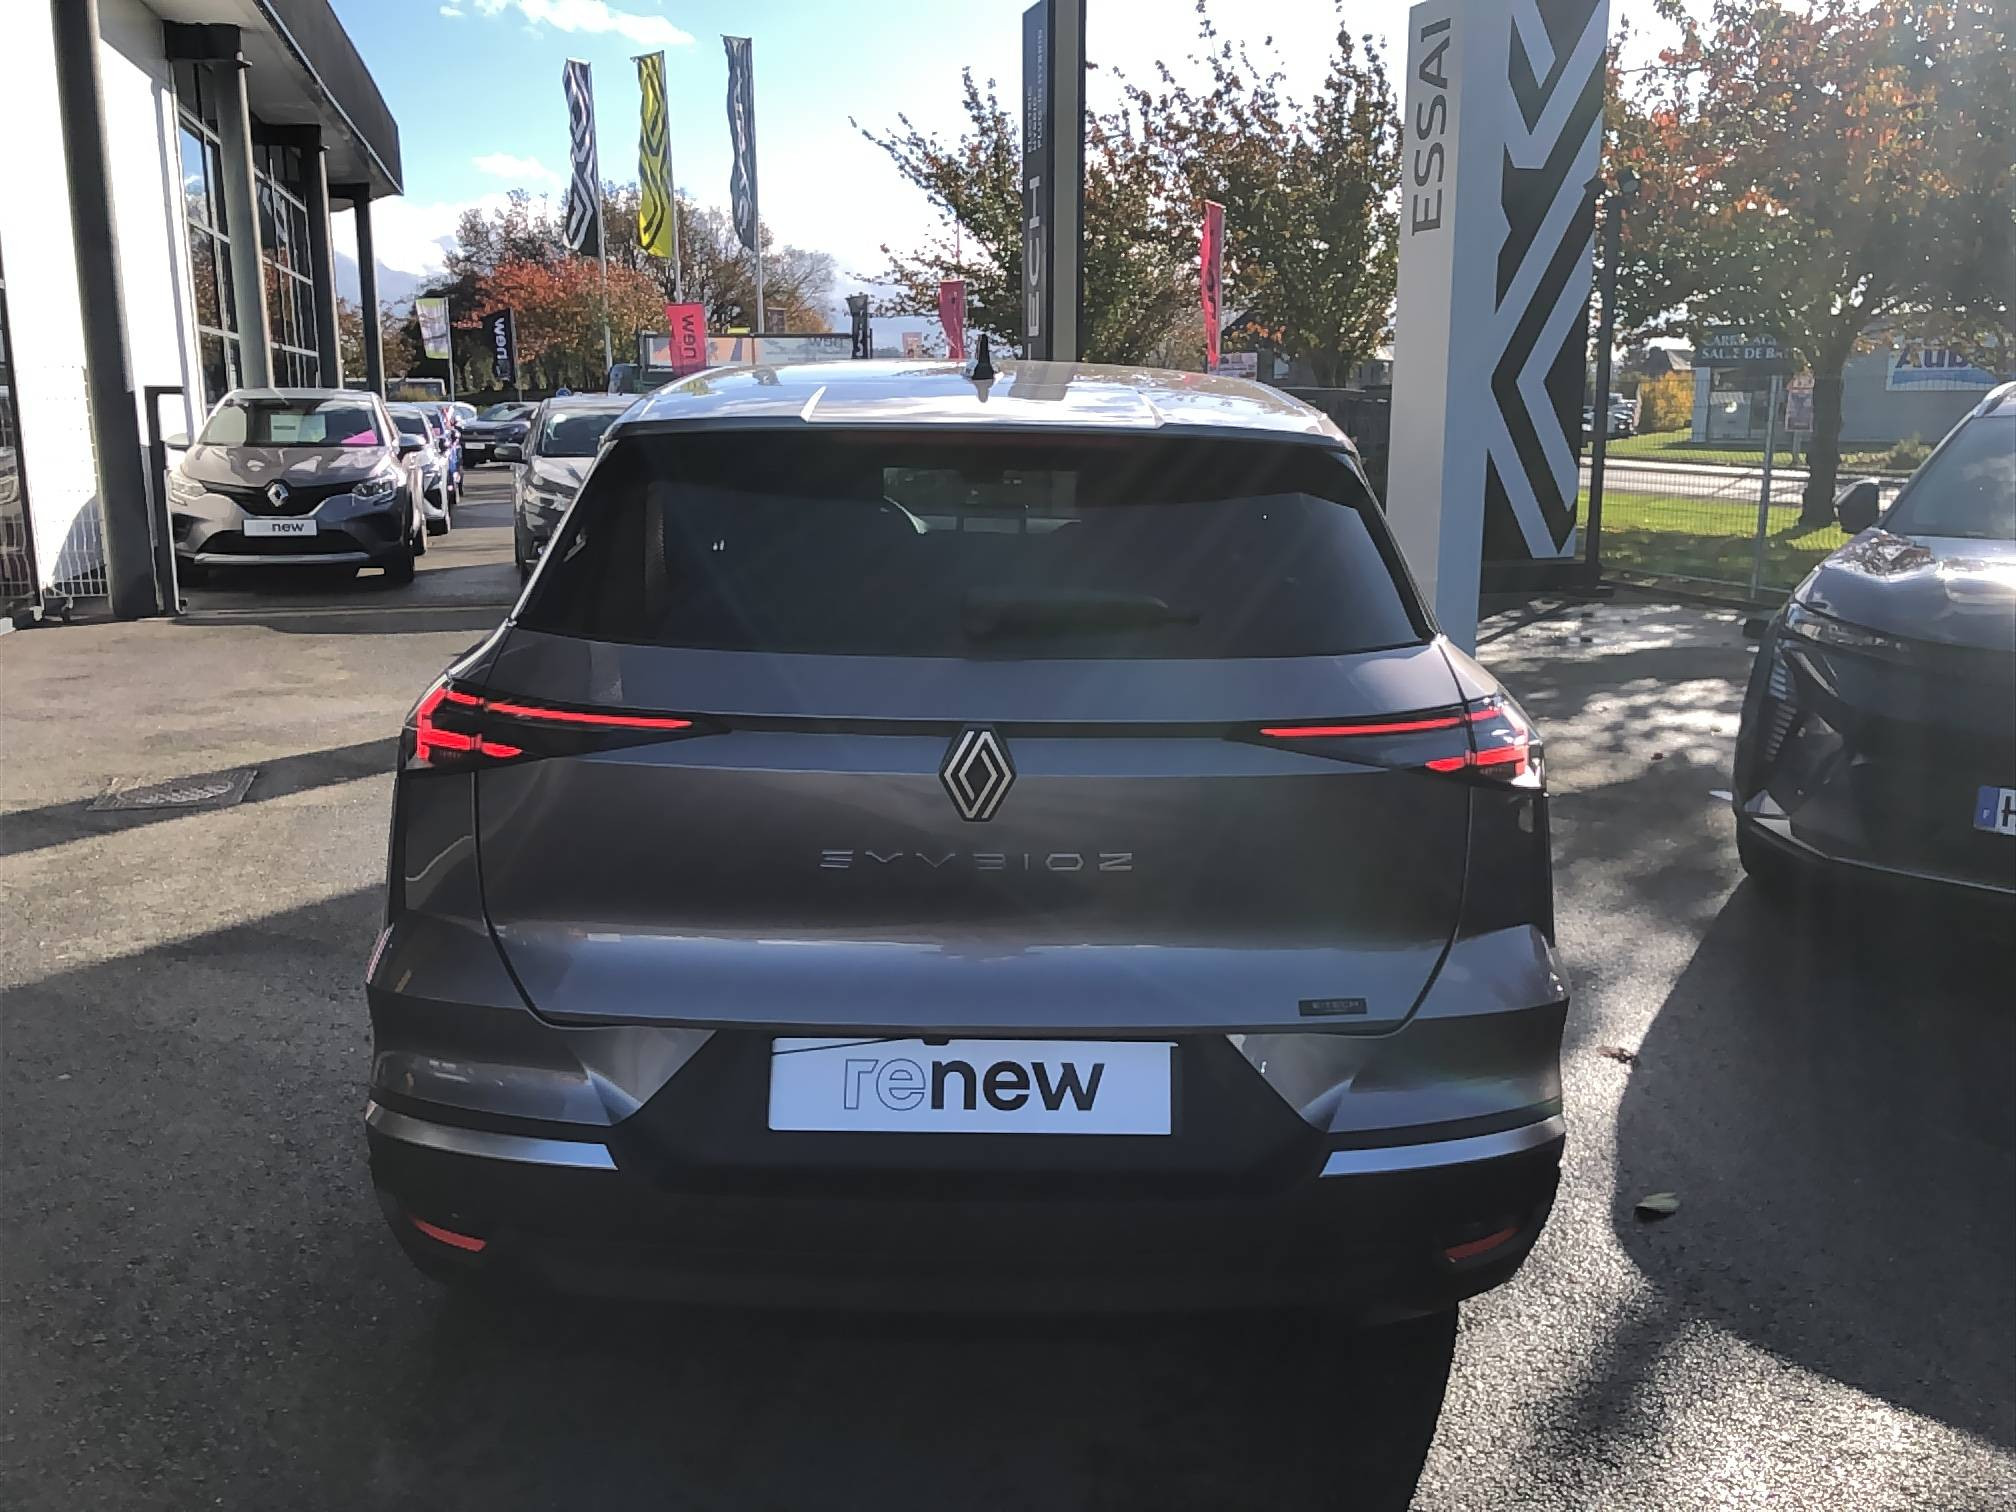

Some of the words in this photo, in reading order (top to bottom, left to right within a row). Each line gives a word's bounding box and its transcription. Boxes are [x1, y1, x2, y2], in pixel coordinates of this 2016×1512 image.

[1411, 18, 1451, 236] ESSAI
[1745, 348, 1763, 359] DE
[272, 523, 304, 532] new
[843, 1058, 1105, 1111] renew
